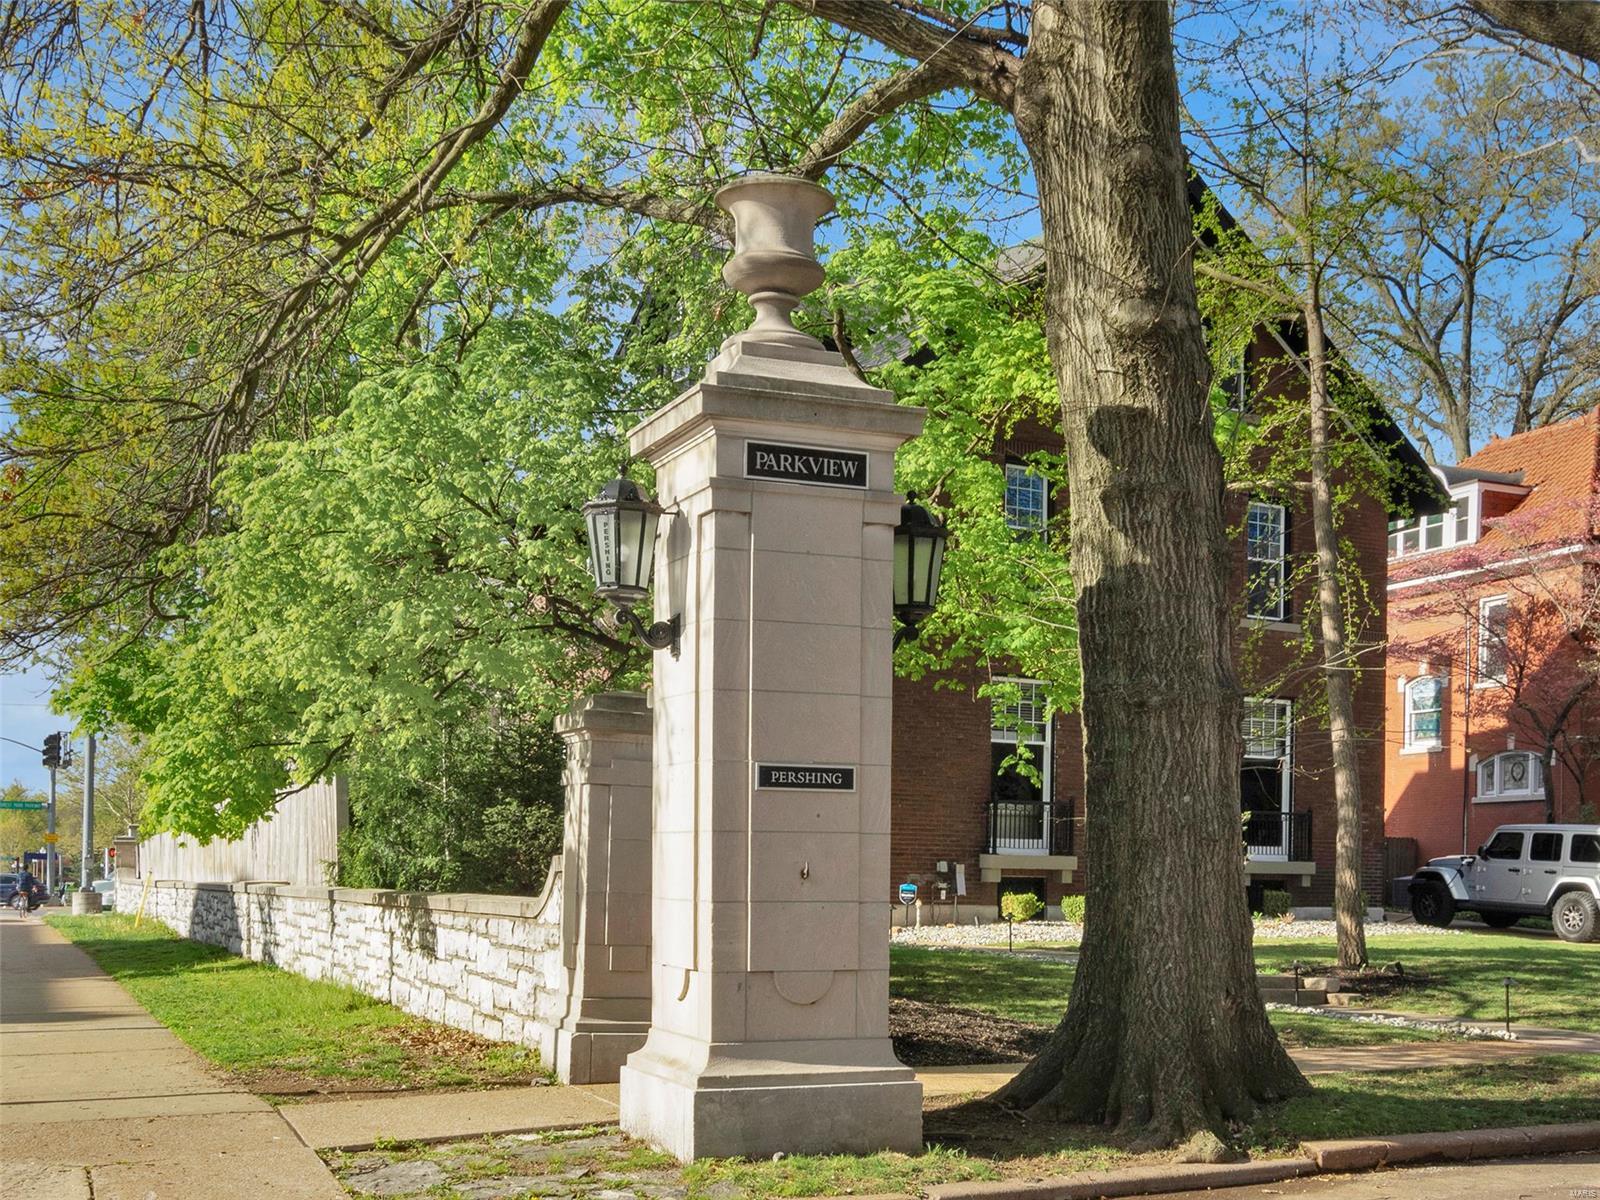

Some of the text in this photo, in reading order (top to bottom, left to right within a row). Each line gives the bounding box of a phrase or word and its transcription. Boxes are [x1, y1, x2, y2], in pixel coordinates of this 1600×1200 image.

[755, 451, 858, 479] PARKVIEW
[603, 521, 612, 576] PERSHING
[770, 770, 843, 785] PERSHING
